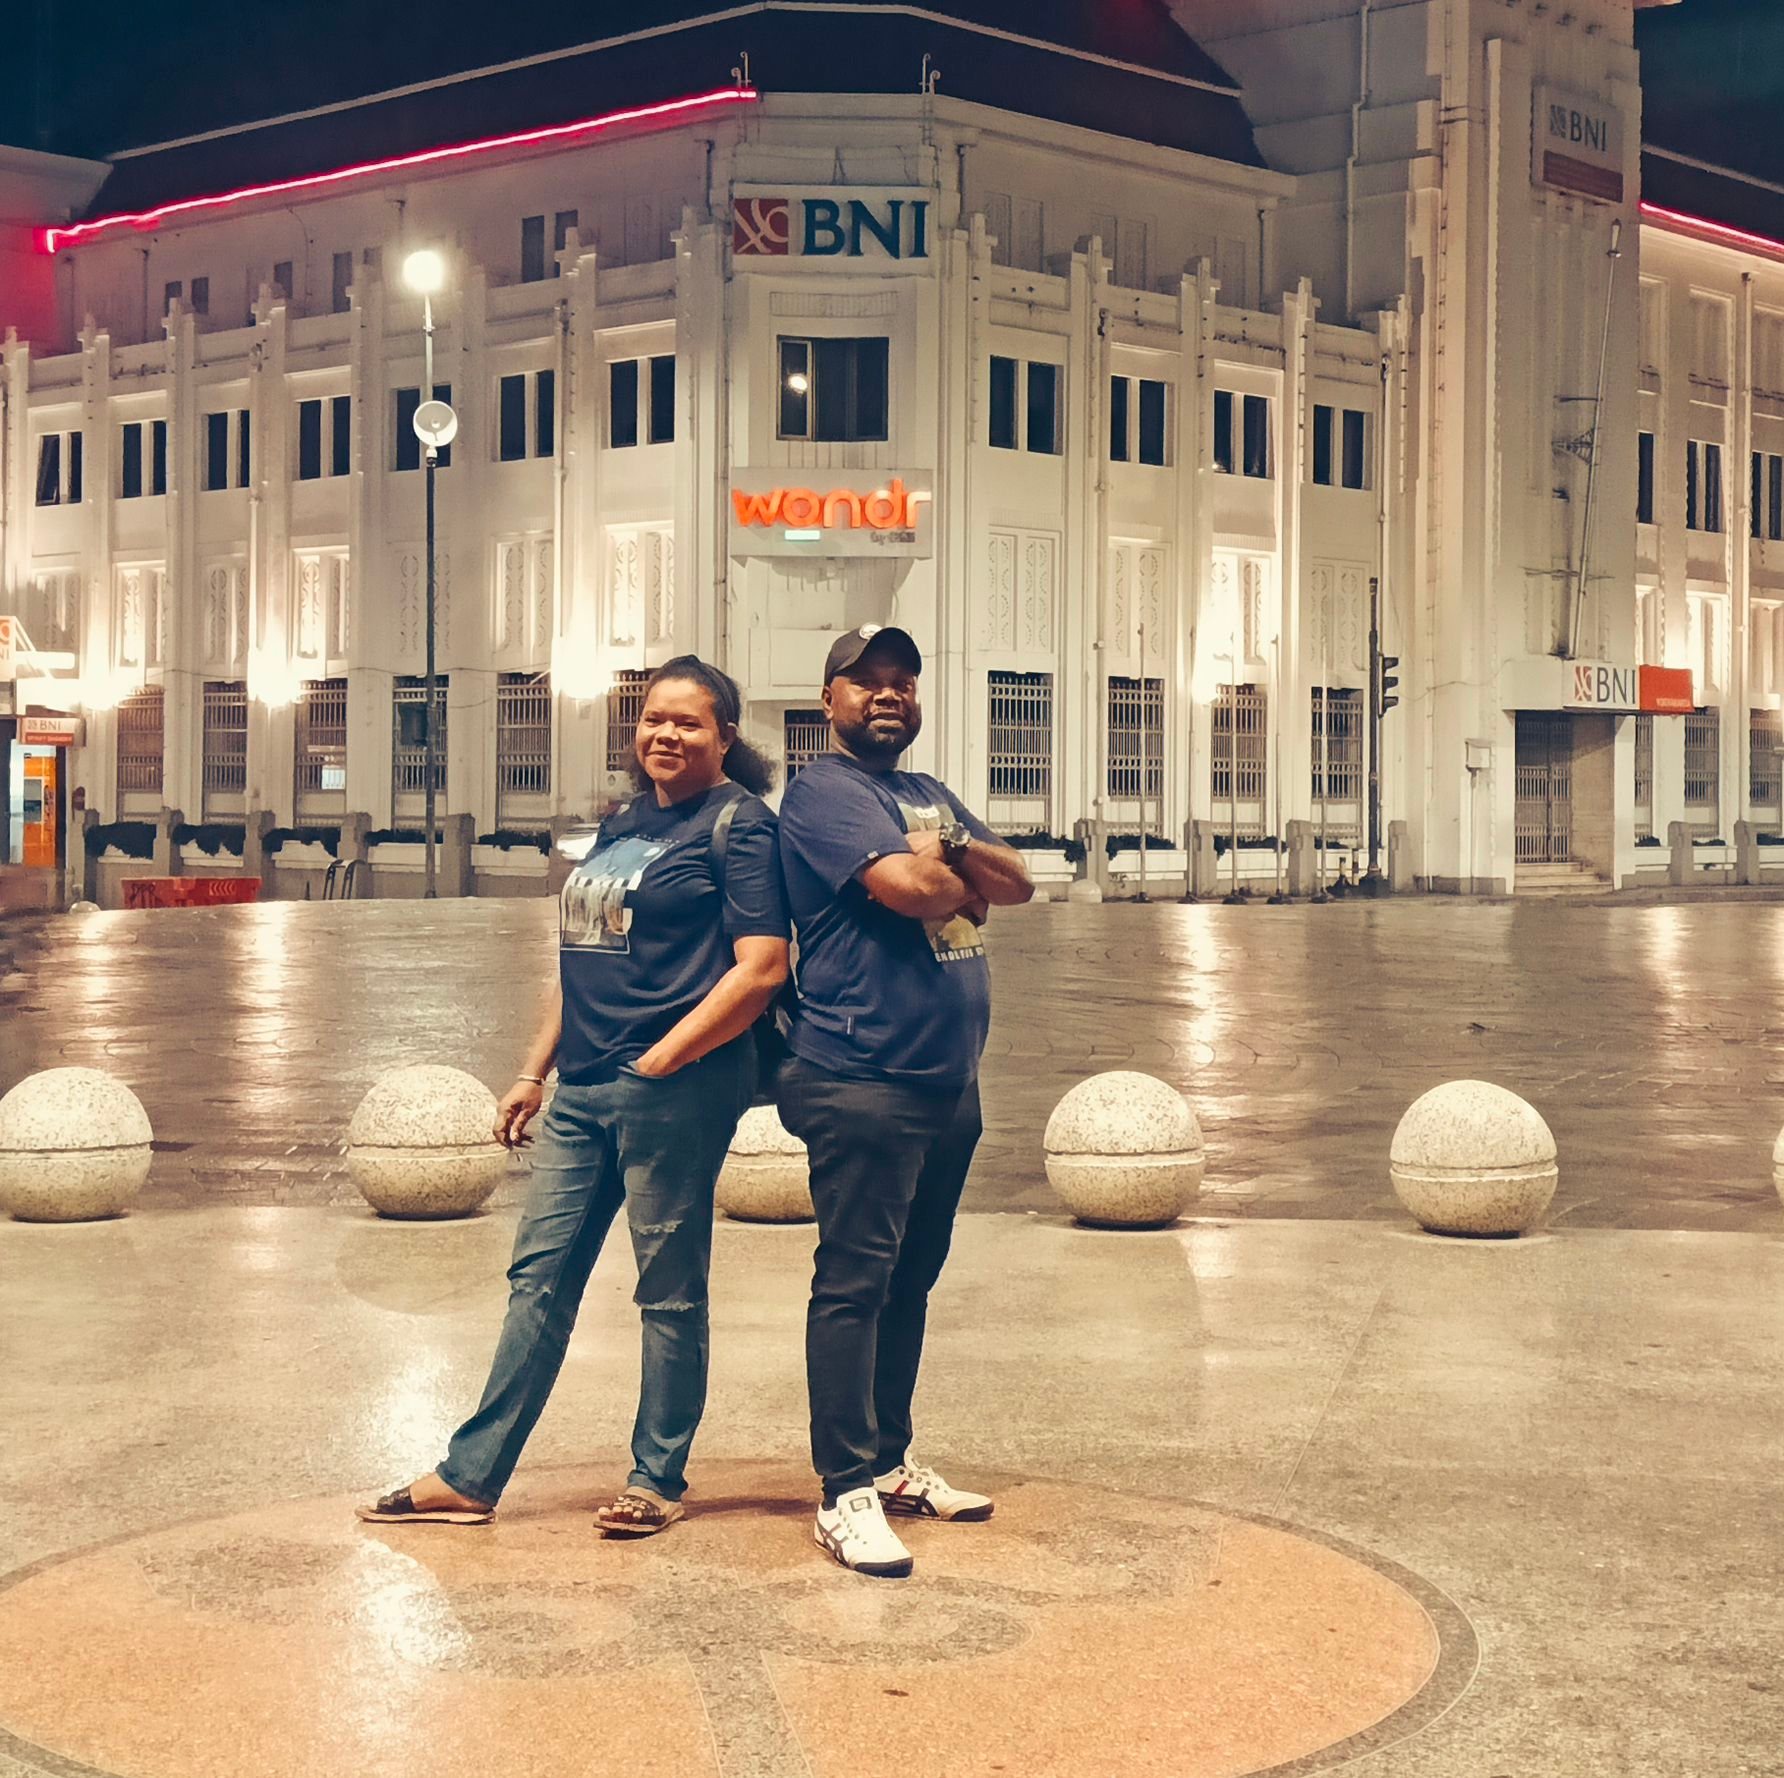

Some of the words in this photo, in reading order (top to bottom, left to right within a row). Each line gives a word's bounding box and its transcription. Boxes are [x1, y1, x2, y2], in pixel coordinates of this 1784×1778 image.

[1570, 110, 1607, 152] BNI
[801, 199, 930, 260] BNI
[732, 478, 932, 529] wondr
[1596, 666, 1636, 705] BNI
[39, 719, 62, 731] BNI
